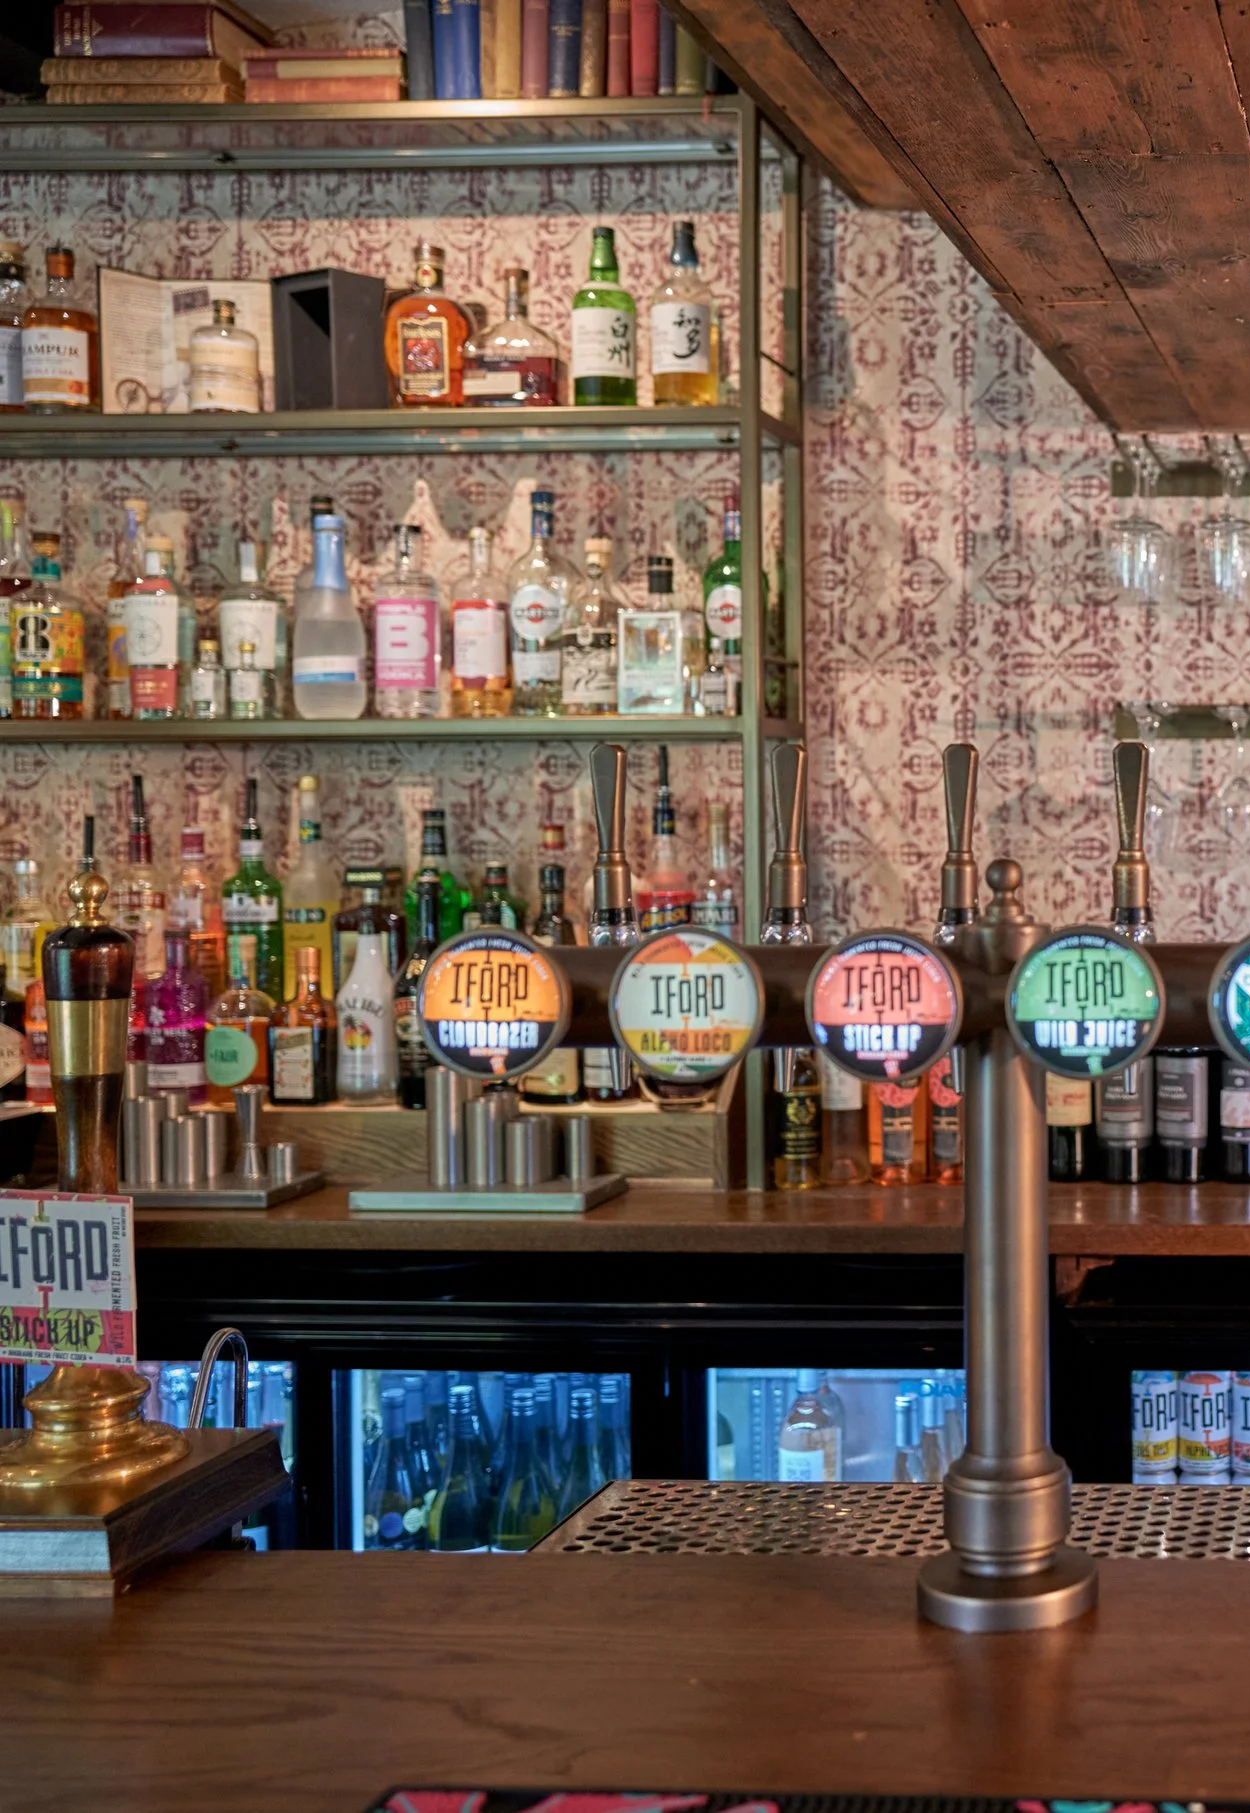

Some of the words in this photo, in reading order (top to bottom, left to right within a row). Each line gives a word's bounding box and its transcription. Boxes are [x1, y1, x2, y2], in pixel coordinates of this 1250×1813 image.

[25, 344, 80, 357] AMPUR
[450, 962, 528, 1008] IFORD
[650, 973, 724, 1019] IFORD
[842, 966, 921, 1012] IFORD
[1044, 961, 1124, 1007] IFORD
[694, 1032, 732, 1052] LOCO
[843, 1024, 894, 1051] STICK
[897, 1024, 922, 1051] UP
[1034, 1020, 1078, 1048] WILD
[1083, 1020, 1137, 1048] JUICE
[112, 1216, 121, 1241] FRUIT
[112, 1242, 122, 1268] FRESH
[0, 1314, 59, 1344] STICK
[66, 1317, 96, 1347] UP
[1132, 1390, 1177, 1431] FORD
[1181, 1388, 1232, 1431] IFOR
